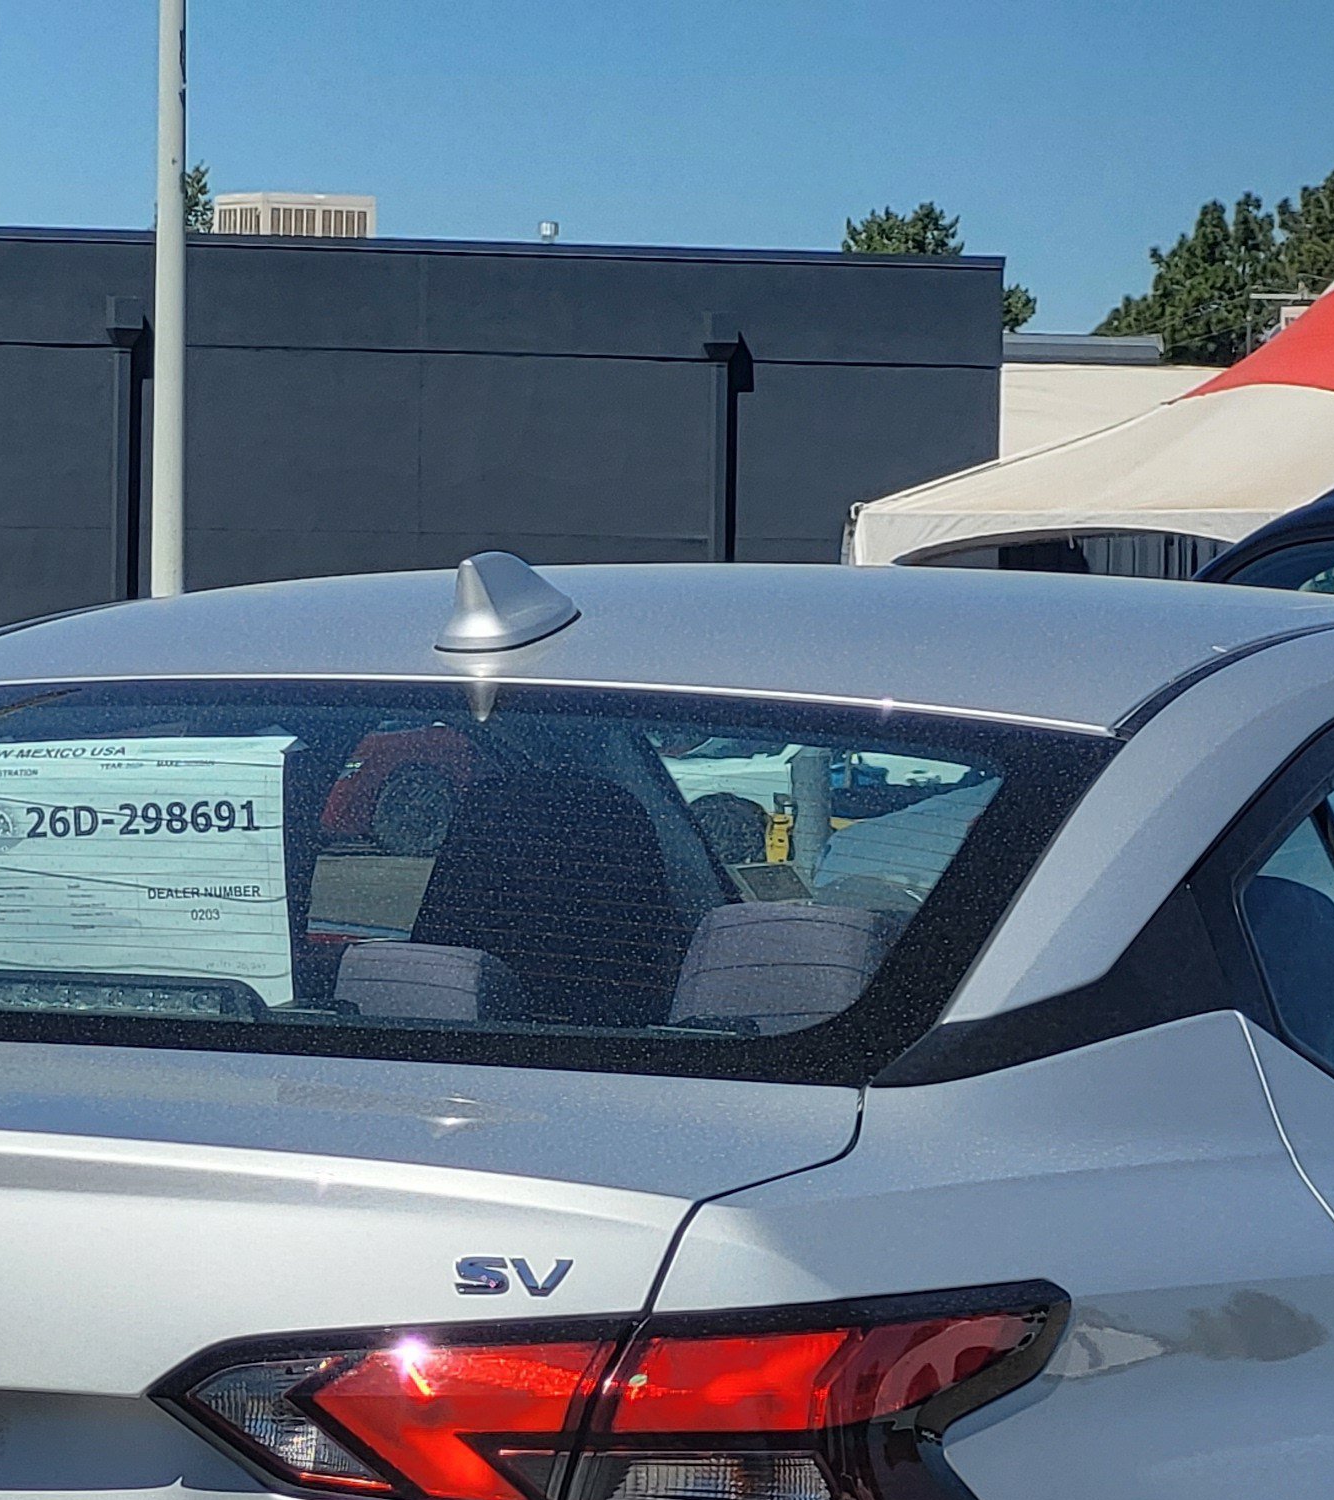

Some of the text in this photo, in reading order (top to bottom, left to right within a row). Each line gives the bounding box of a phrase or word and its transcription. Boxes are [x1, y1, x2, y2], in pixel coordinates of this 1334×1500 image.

[16, 747, 86, 759] MEXICO
[90, 746, 126, 757] USA
[26, 800, 260, 838] 26D-298691
[148, 885, 261, 900] DEALER NUMBER
[190, 908, 220, 921] 0203
[454, 1257, 574, 1297] SV
